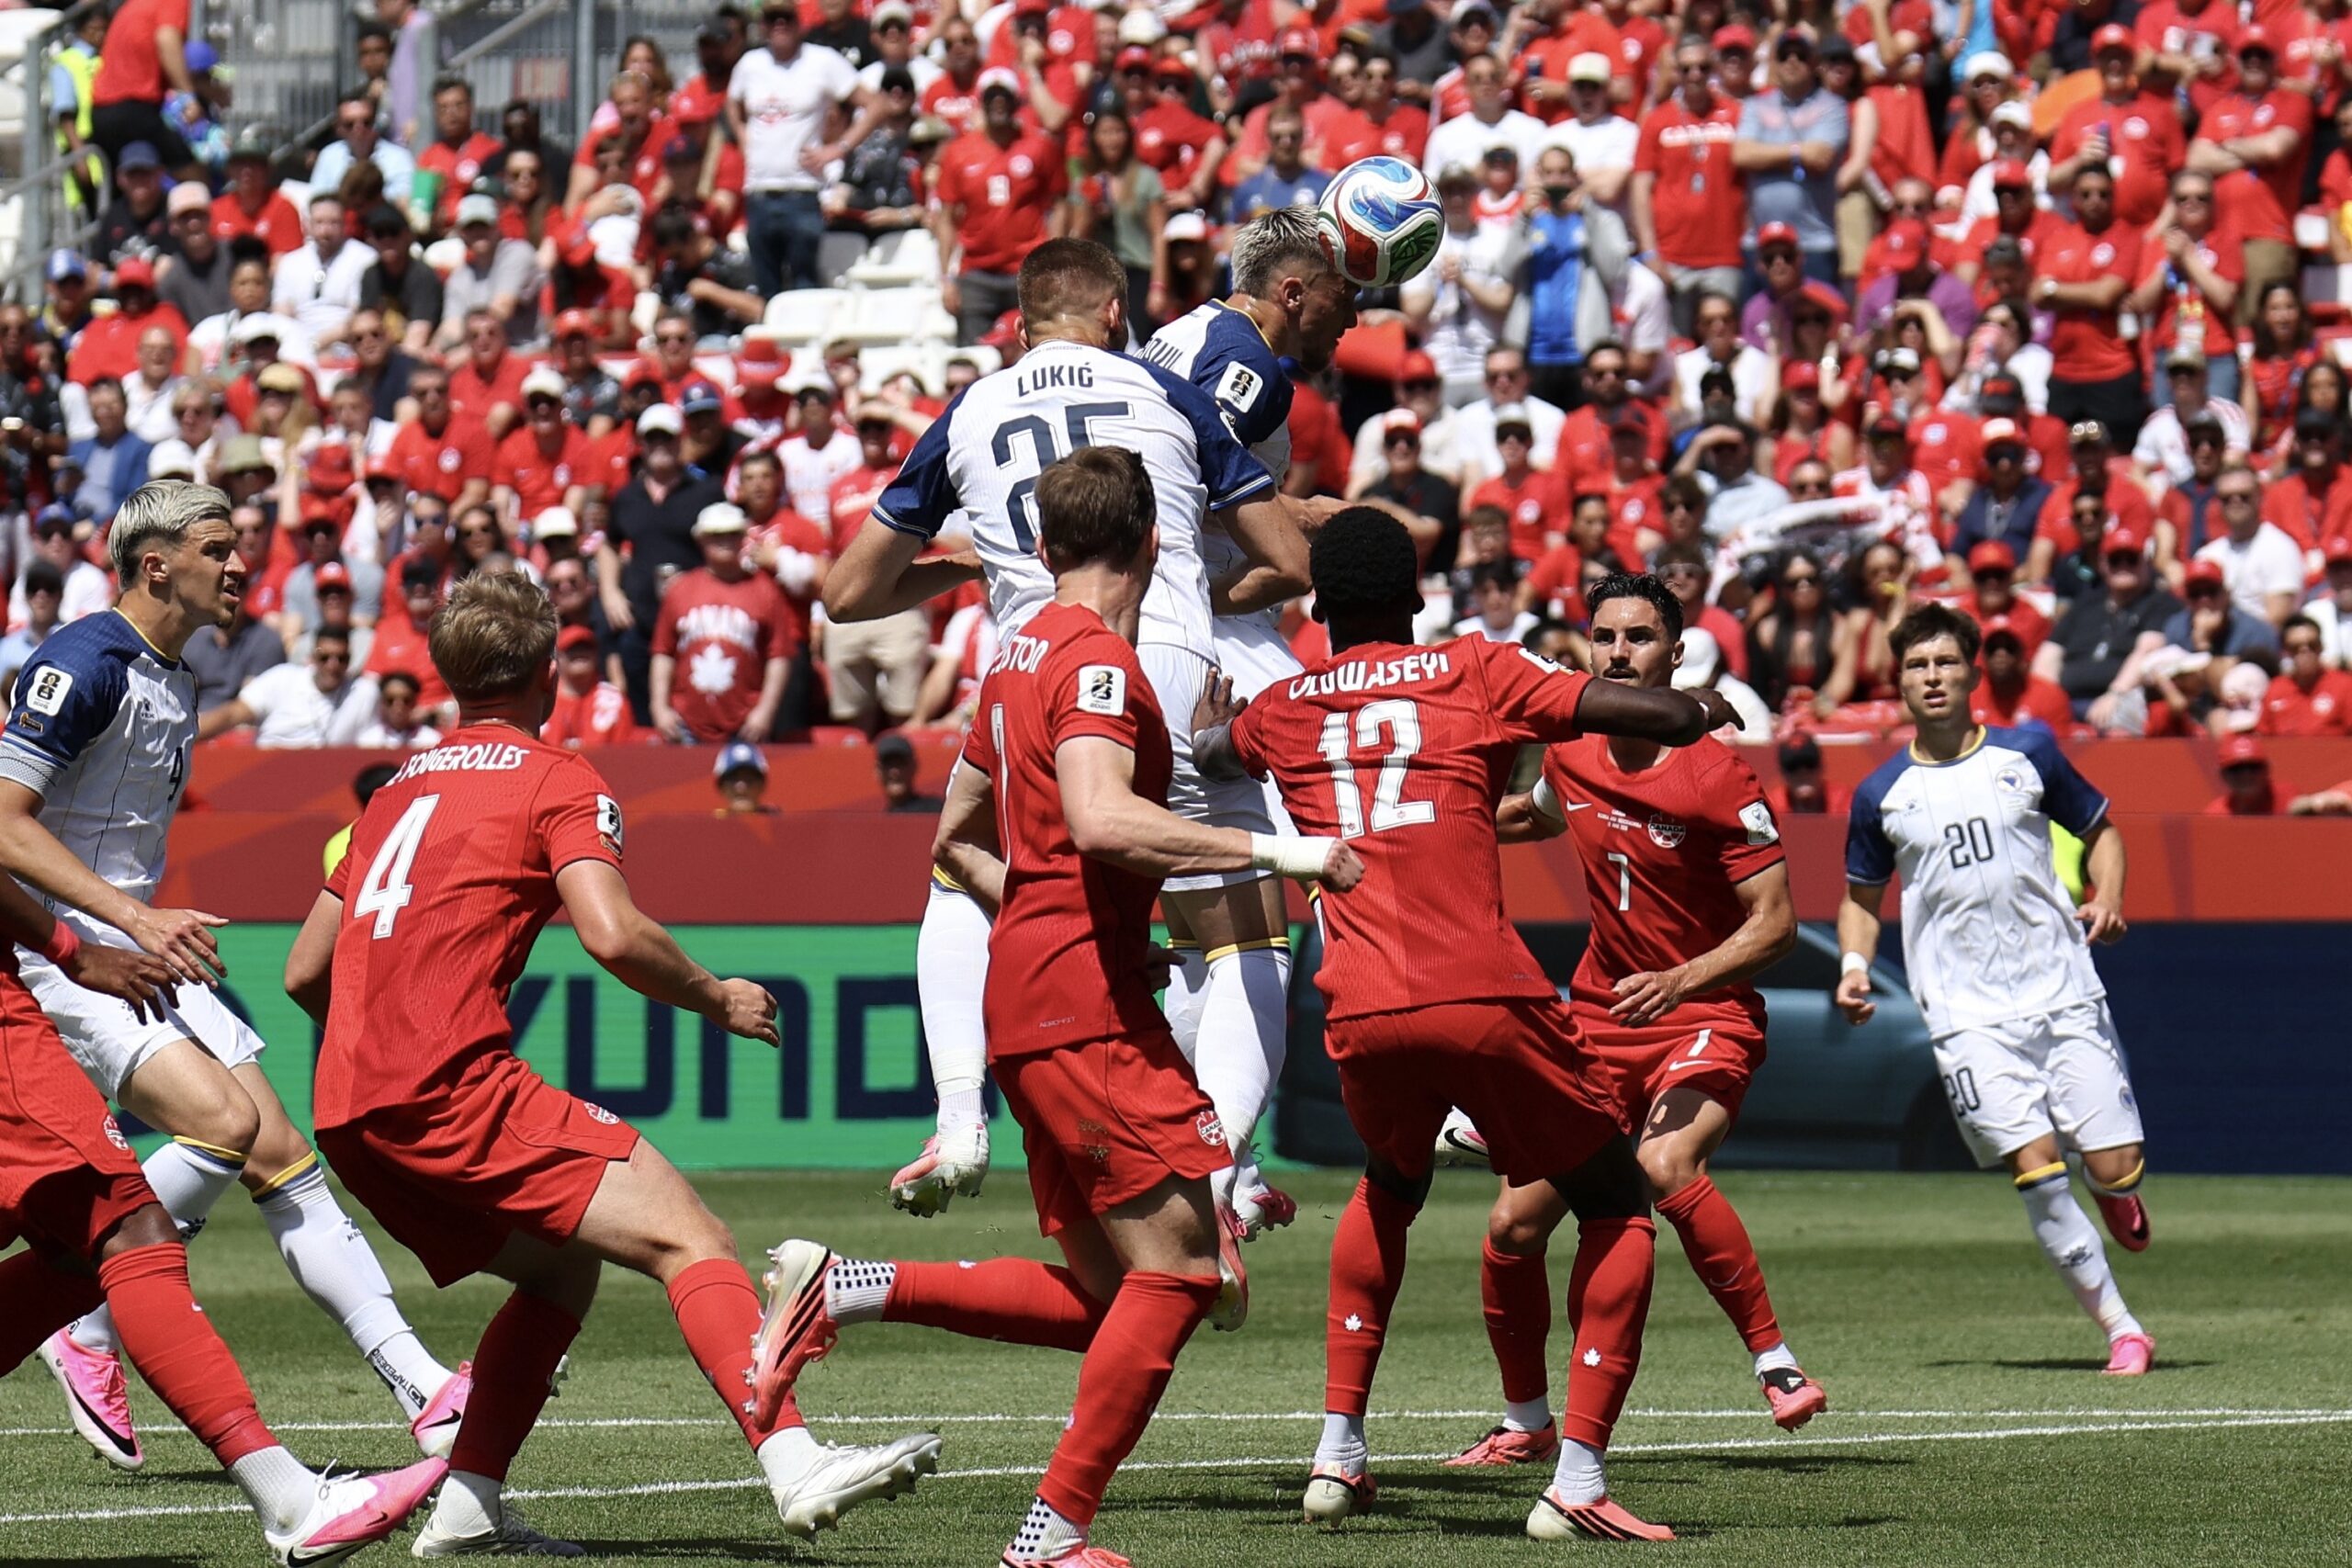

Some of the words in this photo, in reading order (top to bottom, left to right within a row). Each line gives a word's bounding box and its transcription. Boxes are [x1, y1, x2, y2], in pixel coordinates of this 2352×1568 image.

[1018, 362, 1093, 397] LUKIĆ
[1288, 652, 1450, 700] OLUWASEYI
[167, 746, 184, 801] 4
[1317, 699, 1436, 839] 12
[354, 793, 440, 940] 4
[1944, 816, 1995, 869] 20
[1608, 852, 1630, 911] 7
